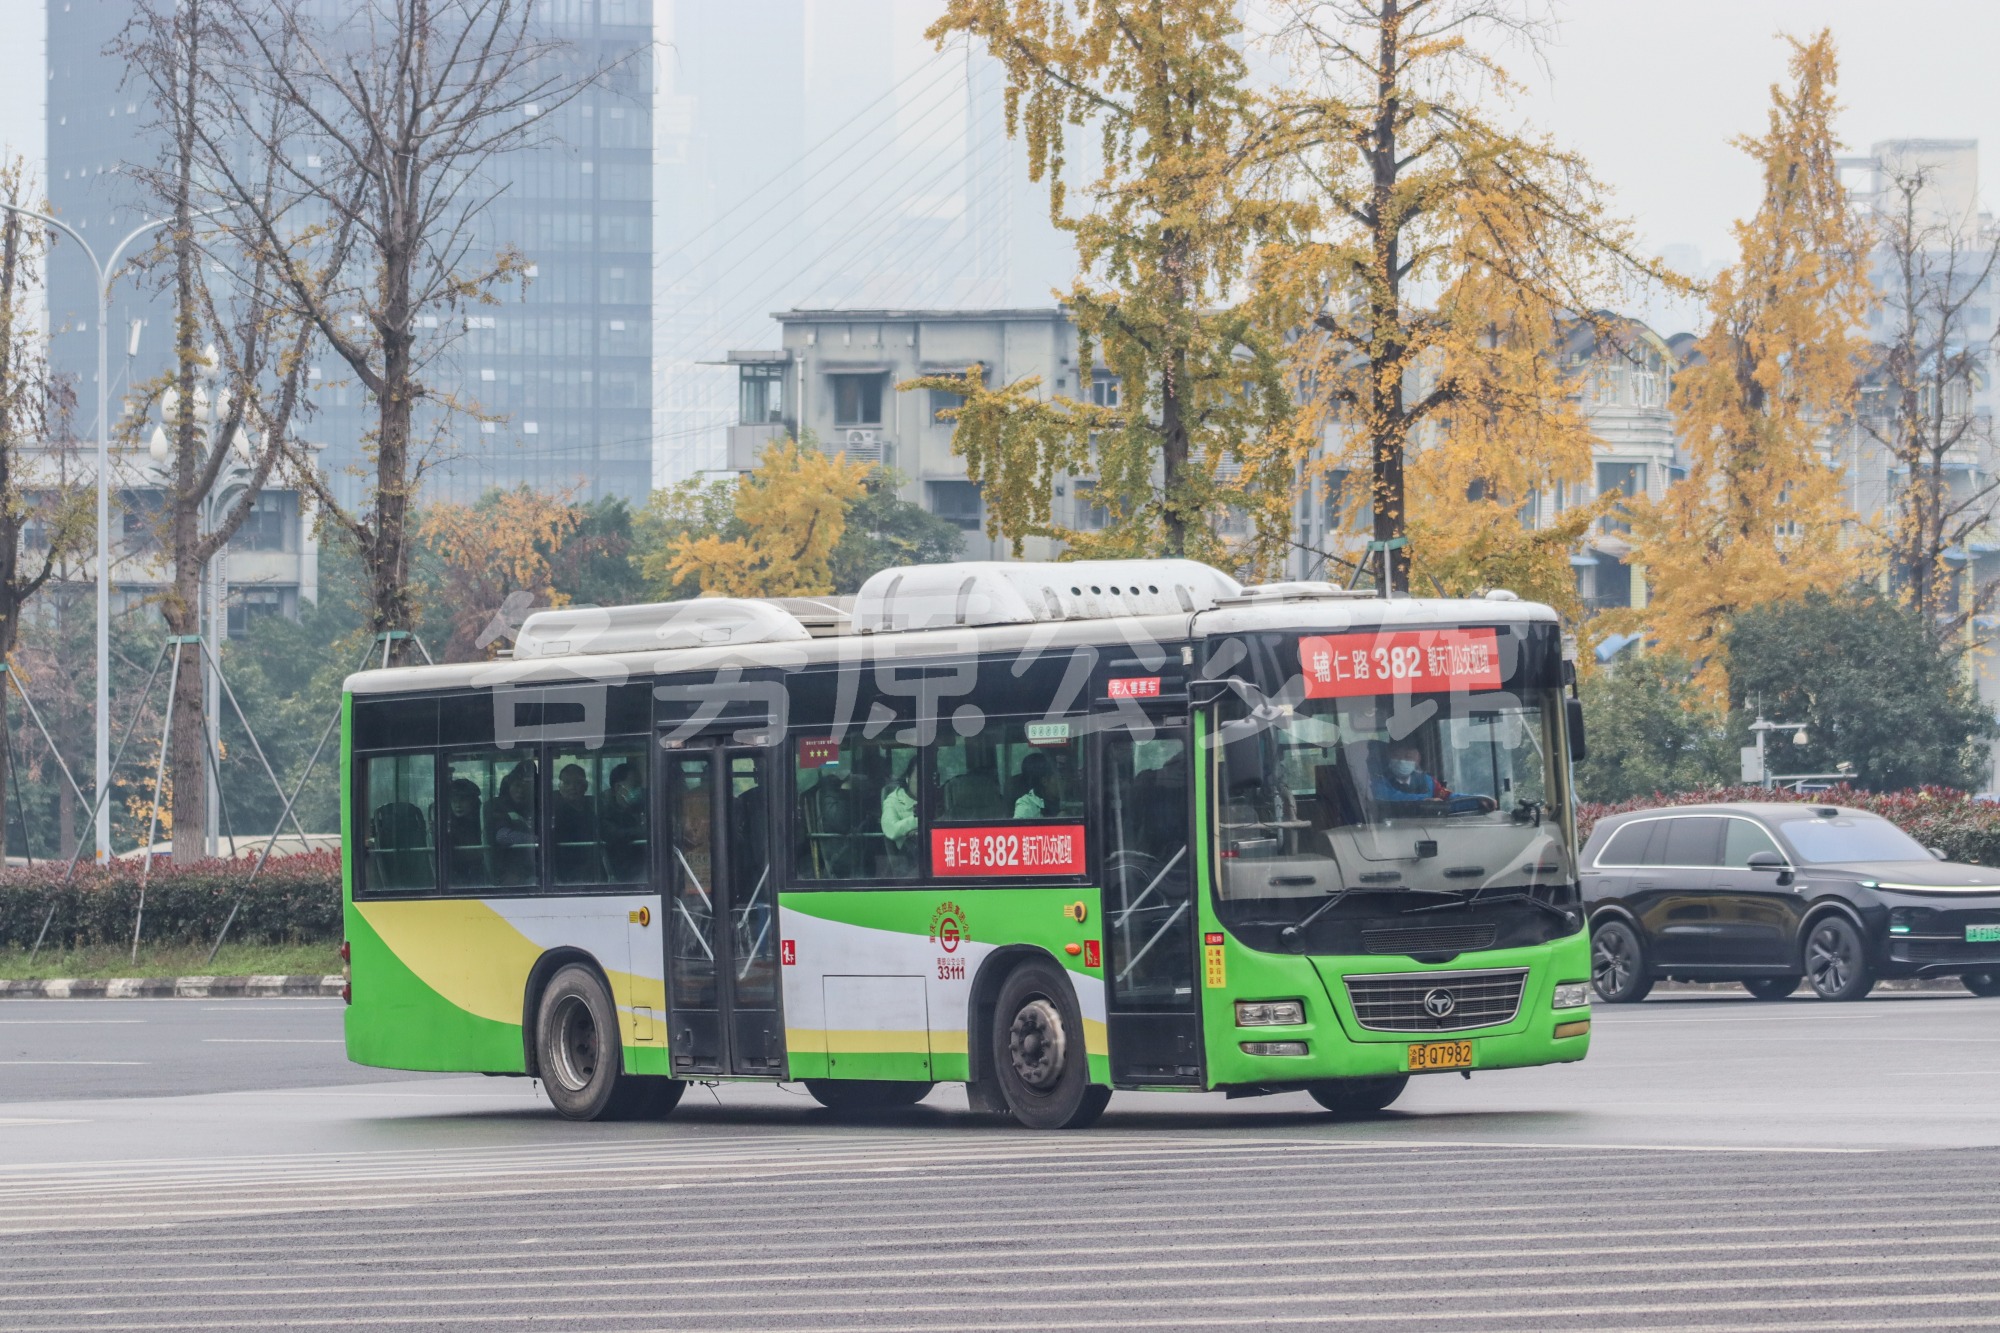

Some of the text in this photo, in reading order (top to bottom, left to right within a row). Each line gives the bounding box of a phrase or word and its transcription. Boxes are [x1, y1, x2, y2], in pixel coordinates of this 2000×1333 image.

[1312, 649, 1370, 683] 辅仁路
[1374, 646, 1422, 680] 382
[1112, 681, 1157, 696] 无人售票车
[944, 836, 980, 867] 辅仁路
[984, 834, 1019, 867] 382
[937, 965, 965, 980] 33111
